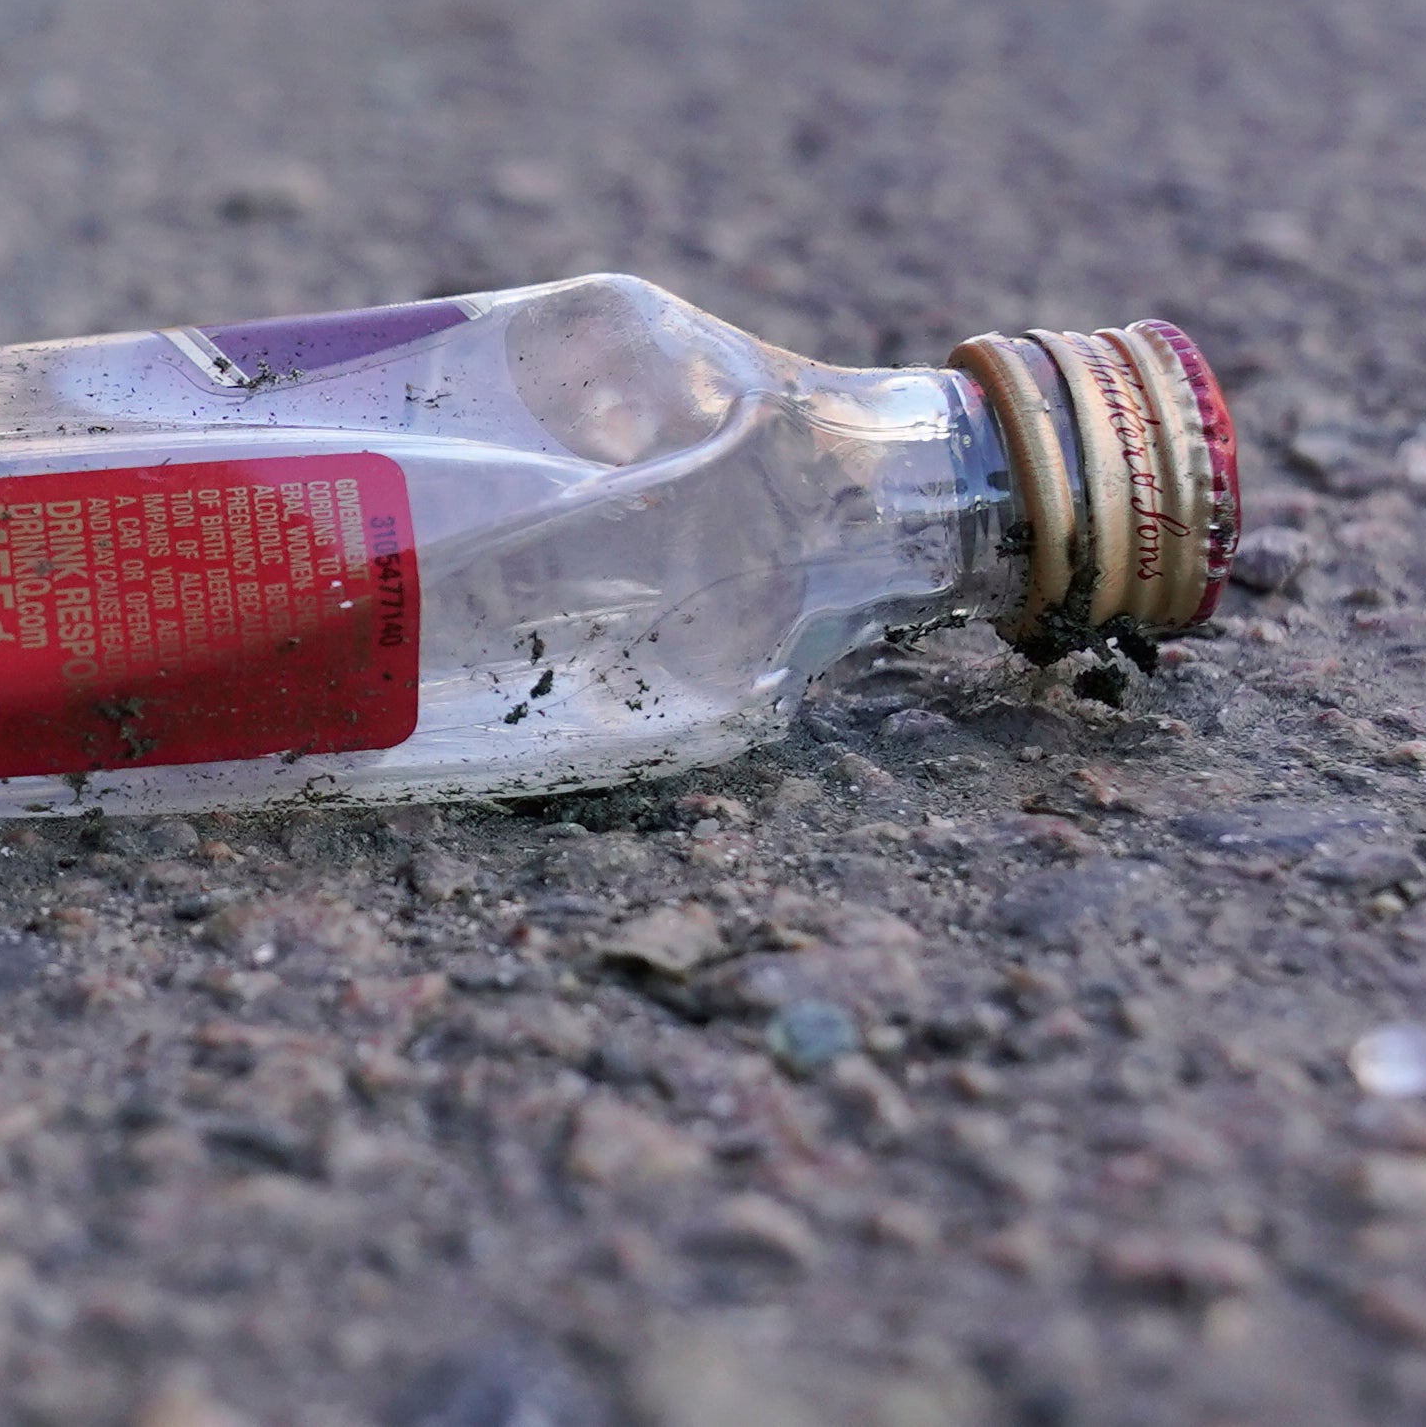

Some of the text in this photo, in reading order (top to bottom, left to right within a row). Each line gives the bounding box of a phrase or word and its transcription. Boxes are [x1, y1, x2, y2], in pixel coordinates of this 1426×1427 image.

[87, 497, 111, 531] AND
[142, 493, 169, 557] IMPAIRS
[170, 489, 194, 527] TION
[197, 489, 220, 506] OF
[252, 484, 283, 565] ALCOHOLIC
[307, 480, 335, 545] CORDING
[46, 500, 89, 581] DRINK
[91, 534, 113, 569] MAY
[175, 539, 196, 559] OF
[200, 515, 226, 560] BIRTH
[225, 486, 256, 577] PREGNANCY
[285, 526, 311, 589] WOMEN
[335, 478, 369, 580] GOVERNMENT
[1131, 495, 1191, 581] Sons
[114, 495, 152, 663] A CAR OR OPERATE
[150, 567, 174, 609] YOUR
[320, 555, 340, 576] TO
[94, 570, 118, 621] CAUSE
